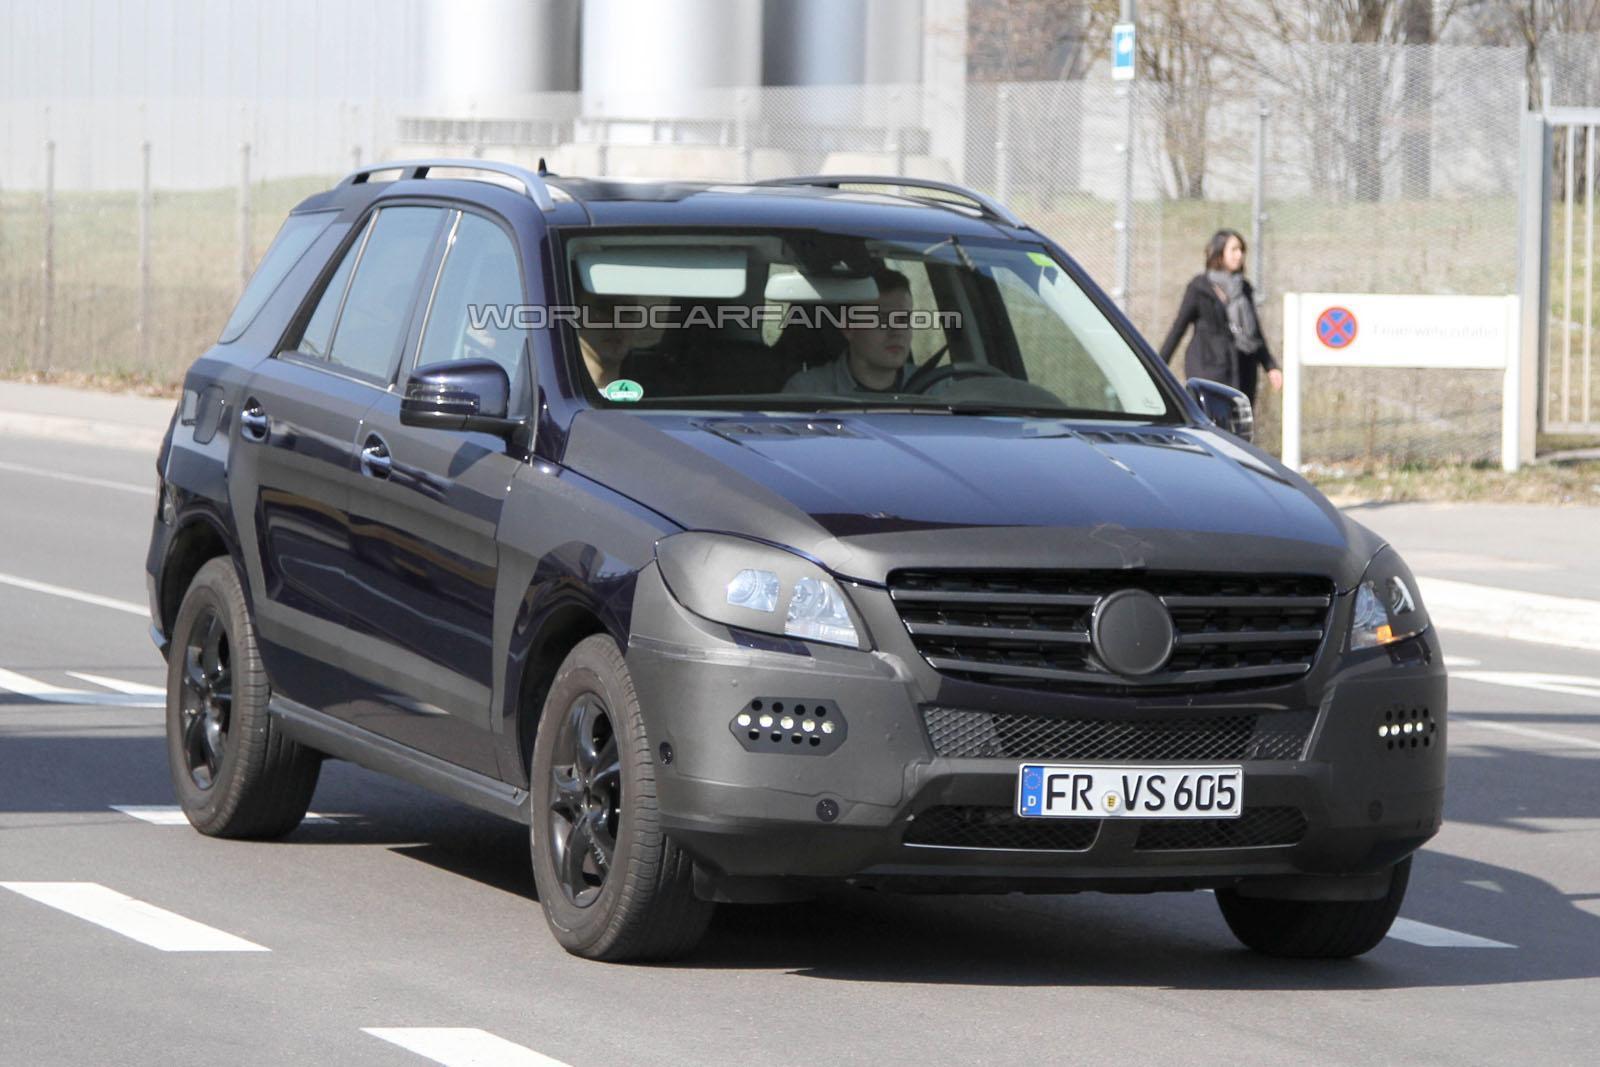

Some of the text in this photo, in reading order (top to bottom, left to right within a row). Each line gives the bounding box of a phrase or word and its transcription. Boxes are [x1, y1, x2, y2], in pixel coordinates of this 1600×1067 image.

[1027, 795, 1037, 807] D
[1046, 774, 1238, 812] FR VS 605
